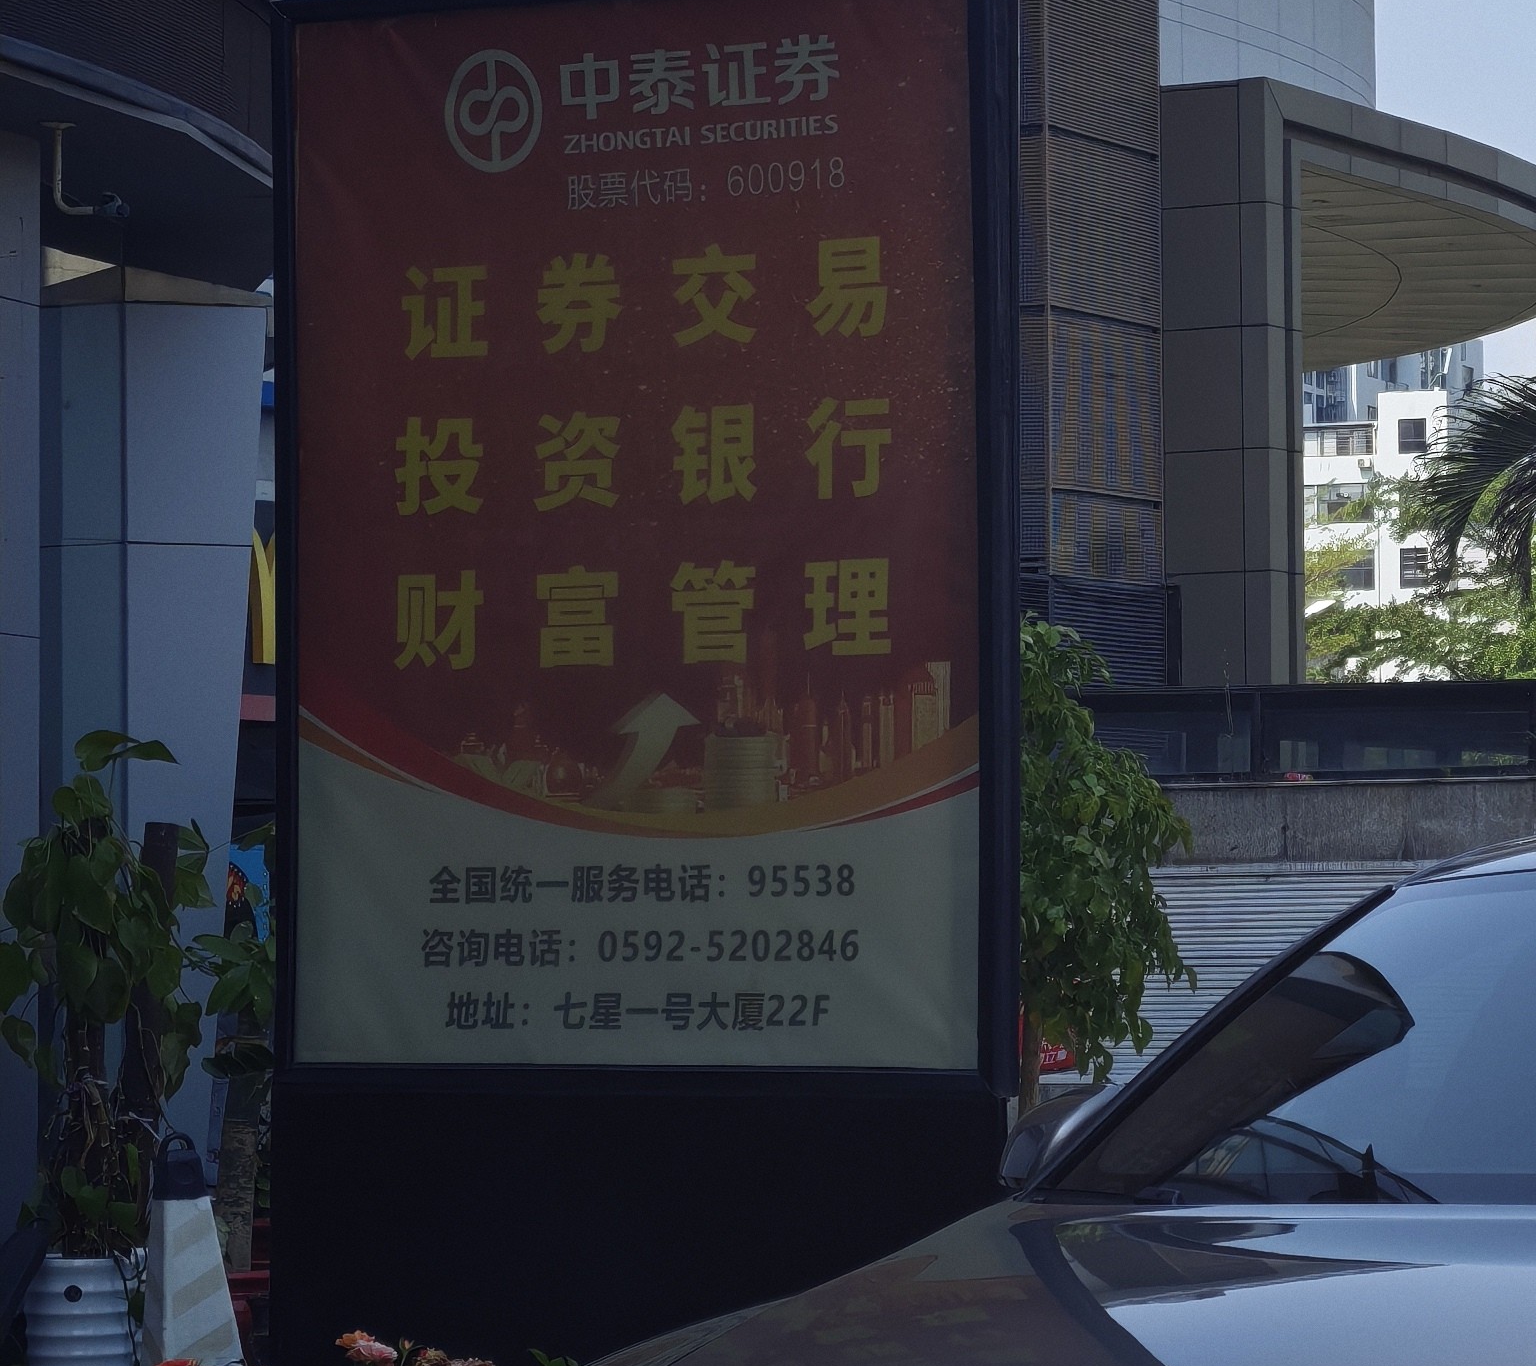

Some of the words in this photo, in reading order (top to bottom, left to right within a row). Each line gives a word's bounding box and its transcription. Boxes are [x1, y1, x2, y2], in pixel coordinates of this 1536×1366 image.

[560, 34, 840, 120] 中泰证券
[563, 126, 691, 154] ZHONGTAI
[700, 114, 839, 145] SECURITIES
[401, 236, 890, 361] 证券交易
[394, 397, 893, 516] 投资银行
[393, 558, 892, 670] 财富管理
